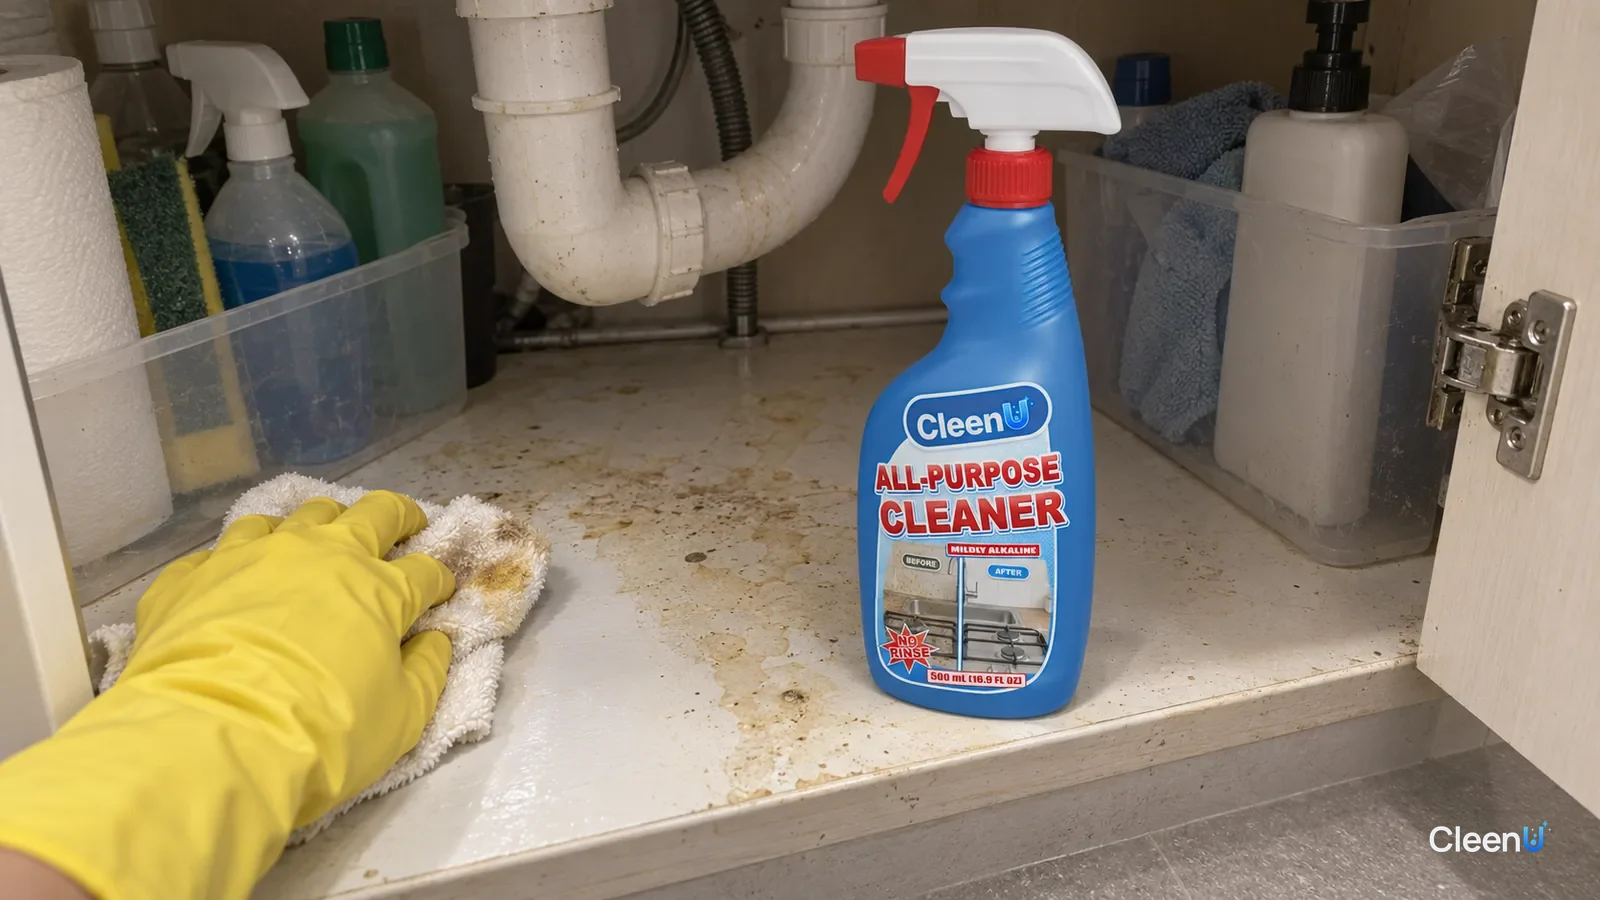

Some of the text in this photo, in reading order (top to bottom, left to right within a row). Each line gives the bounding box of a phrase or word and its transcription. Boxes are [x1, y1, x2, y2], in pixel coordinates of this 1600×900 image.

[917, 399, 1030, 440] CleenU
[876, 454, 1061, 491] ALL-PURPOSE
[880, 492, 1068, 534] CLEANER
[950, 545, 1037, 555] MILDLY ALKALINE
[905, 556, 937, 568] BEFORE
[994, 567, 1022, 577] AFTER
[897, 635, 917, 647] NO
[890, 647, 931, 659] RINSE
[930, 671, 949, 682] 500
[994, 674, 1005, 684] FL
